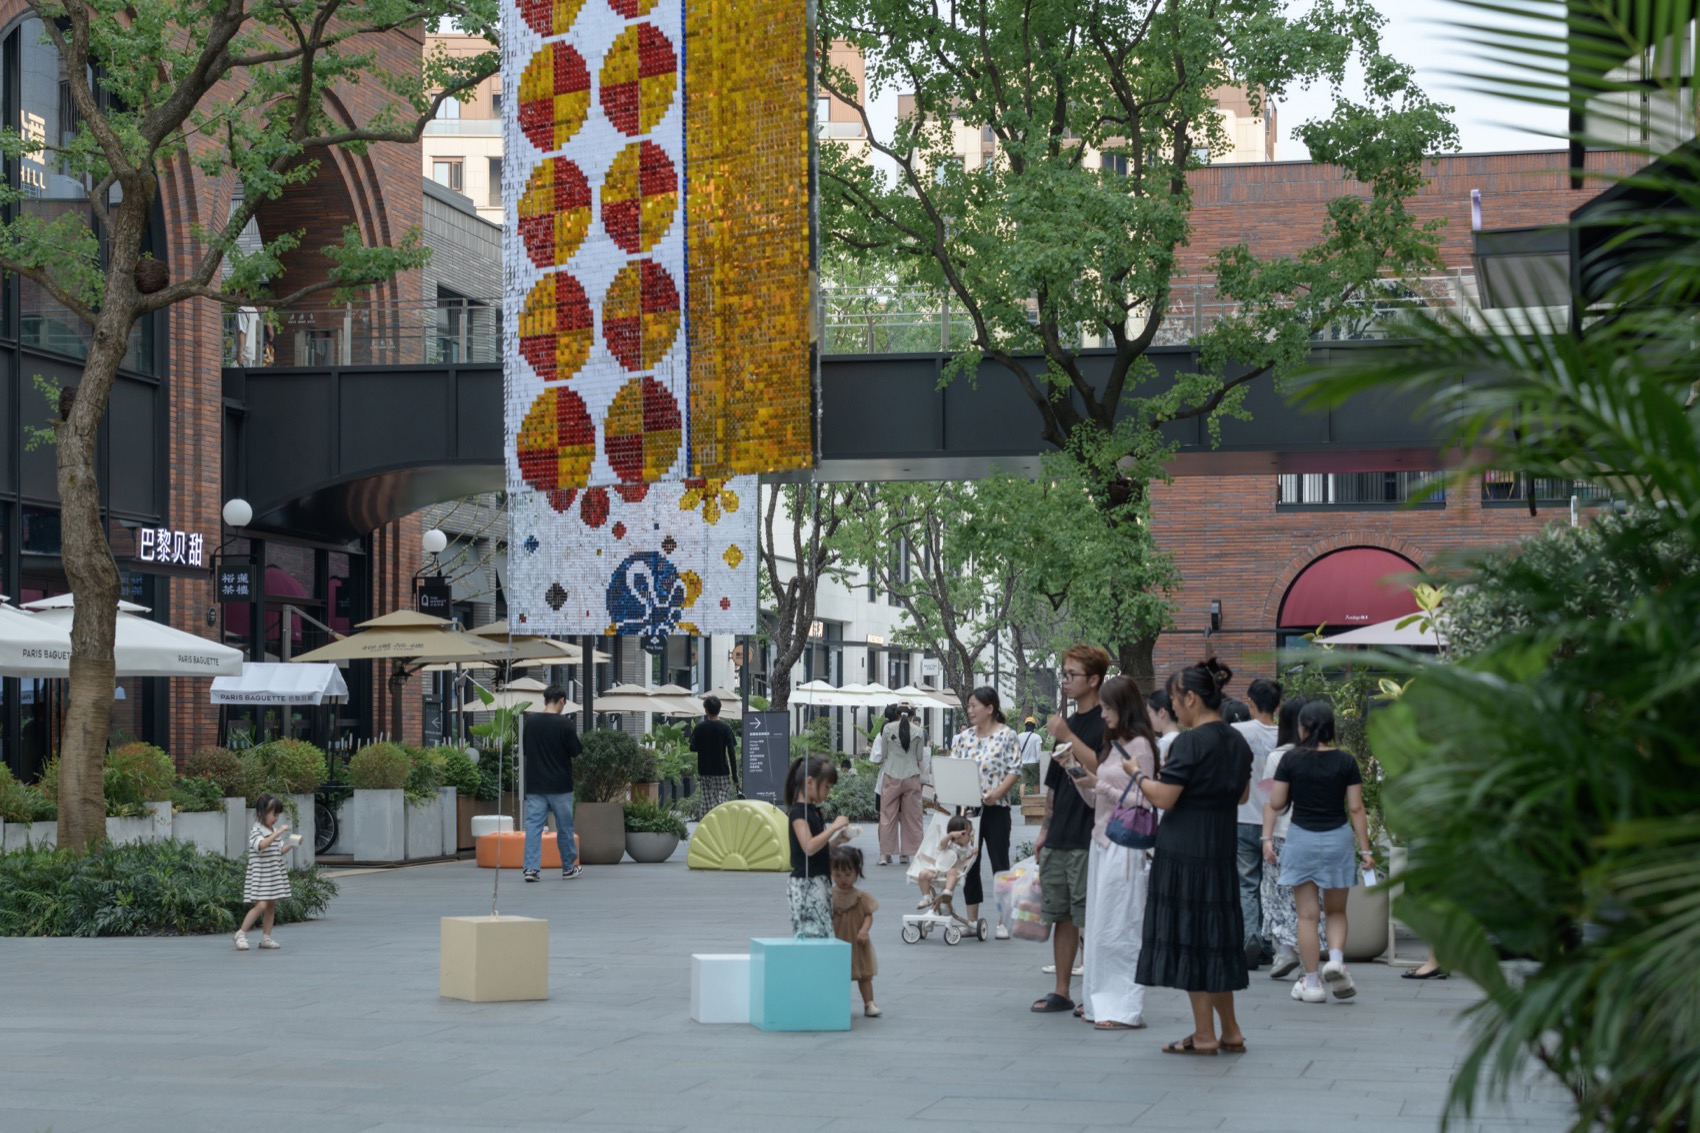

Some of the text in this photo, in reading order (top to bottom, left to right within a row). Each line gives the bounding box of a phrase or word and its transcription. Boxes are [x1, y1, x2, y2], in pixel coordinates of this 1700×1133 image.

[140, 527, 204, 567] 巴黎贝甜
[22, 648, 73, 661] PARIS BAGUET
[178, 654, 220, 667] PARIS BAGUETTE
[220, 693, 243, 702] PARIS
[245, 694, 286, 702] BAGUETTE
